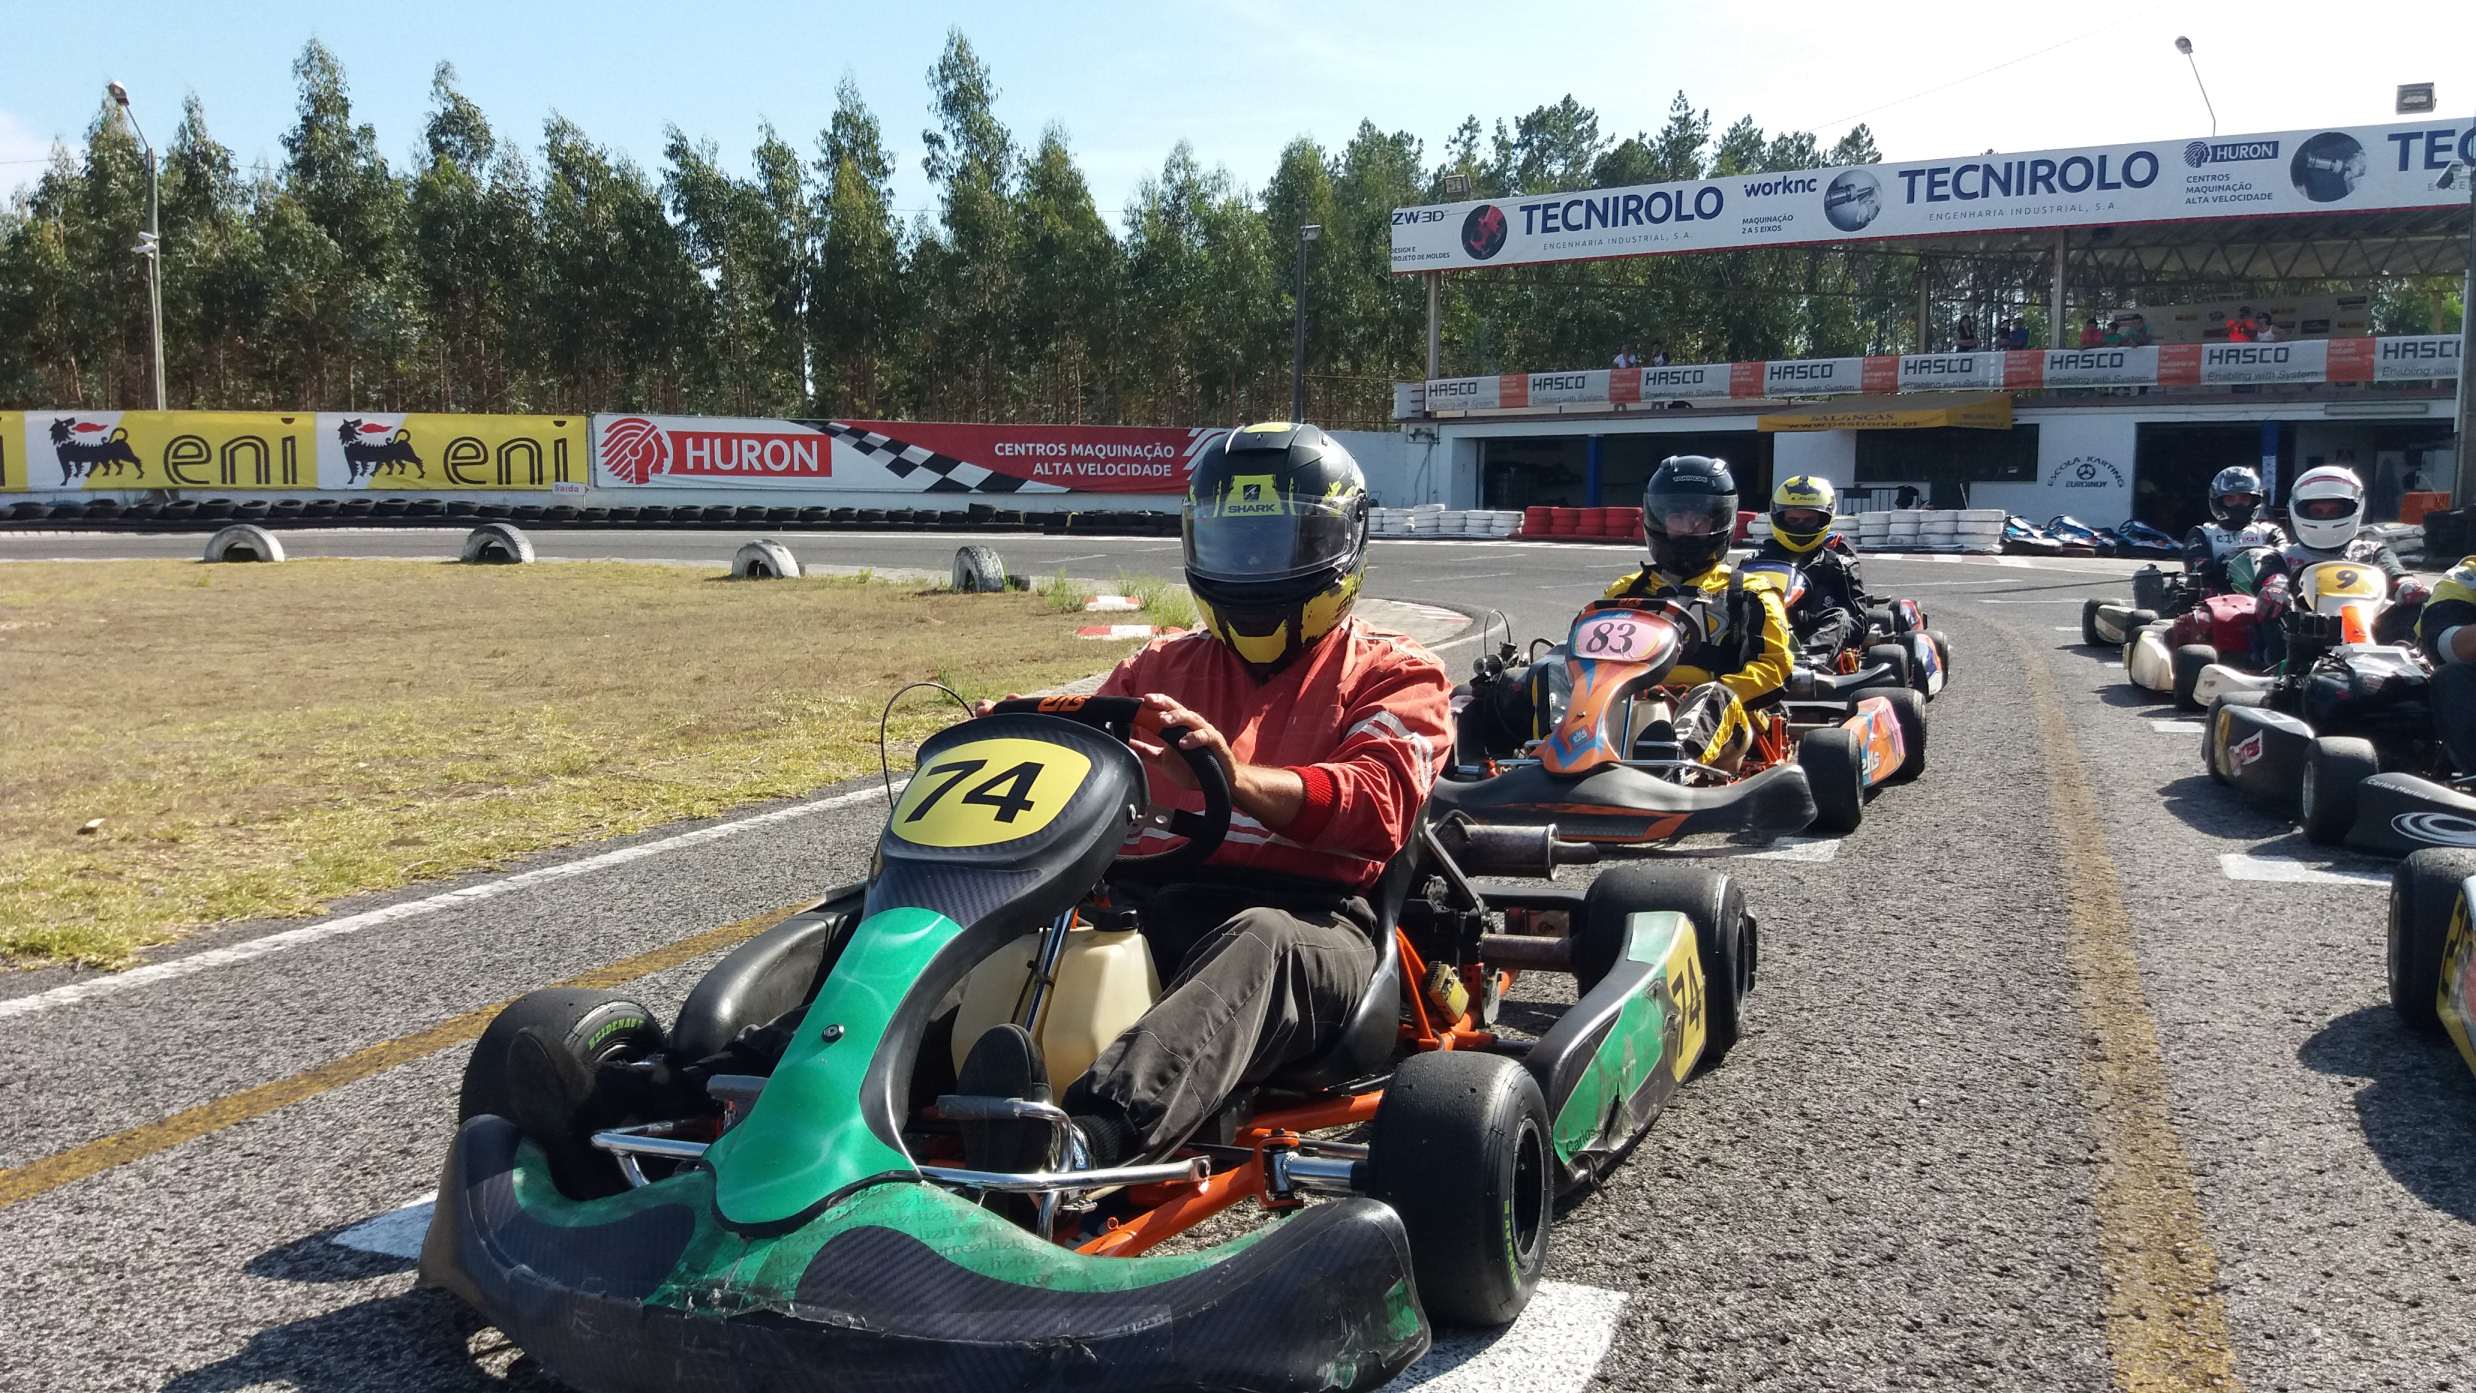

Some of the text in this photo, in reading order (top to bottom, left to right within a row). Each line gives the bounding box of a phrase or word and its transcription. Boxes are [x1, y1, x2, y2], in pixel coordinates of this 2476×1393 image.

[2216, 143, 2273, 160] HURON
[1898, 150, 2159, 204] TECNIROLO
[2186, 173, 2231, 184] CENTROS
[1744, 175, 1817, 198] worknc
[2185, 181, 2252, 194] MAQUINAÇÃO
[2185, 192, 2273, 205] ALTA VELOCIDADE
[1519, 186, 1724, 235] TECNIROLO
[1929, 208, 2004, 222] ENGENHARIA
[1760, 225, 1782, 233] EIXOS
[1543, 238, 1604, 251] ENGENHARIA
[1426, 252, 1450, 260] MOLDES
[2050, 352, 2124, 370] HASCO
[2208, 347, 2289, 365] HASCO
[1769, 363, 1834, 380] HASCO
[1904, 358, 1973, 375] HASCO
[1532, 376, 1586, 392] HASCO
[1645, 369, 1704, 386] HASCO
[1428, 382, 1477, 397] HASCO
[163, 416, 297, 485] eni
[443, 419, 568, 485] eni
[686, 436, 818, 473] HURON
[994, 442, 1175, 460] CENTROS MAQUINAÇÃO
[1032, 462, 1173, 477] ALTA VELOCIDADE
[1228, 503, 1275, 514] SHARK
[2336, 570, 2359, 590] 9
[1585, 622, 1637, 654] 83
[904, 759, 1045, 824] 74
[1671, 956, 1702, 1058] 74
[1566, 1127, 1597, 1154] Carlos
